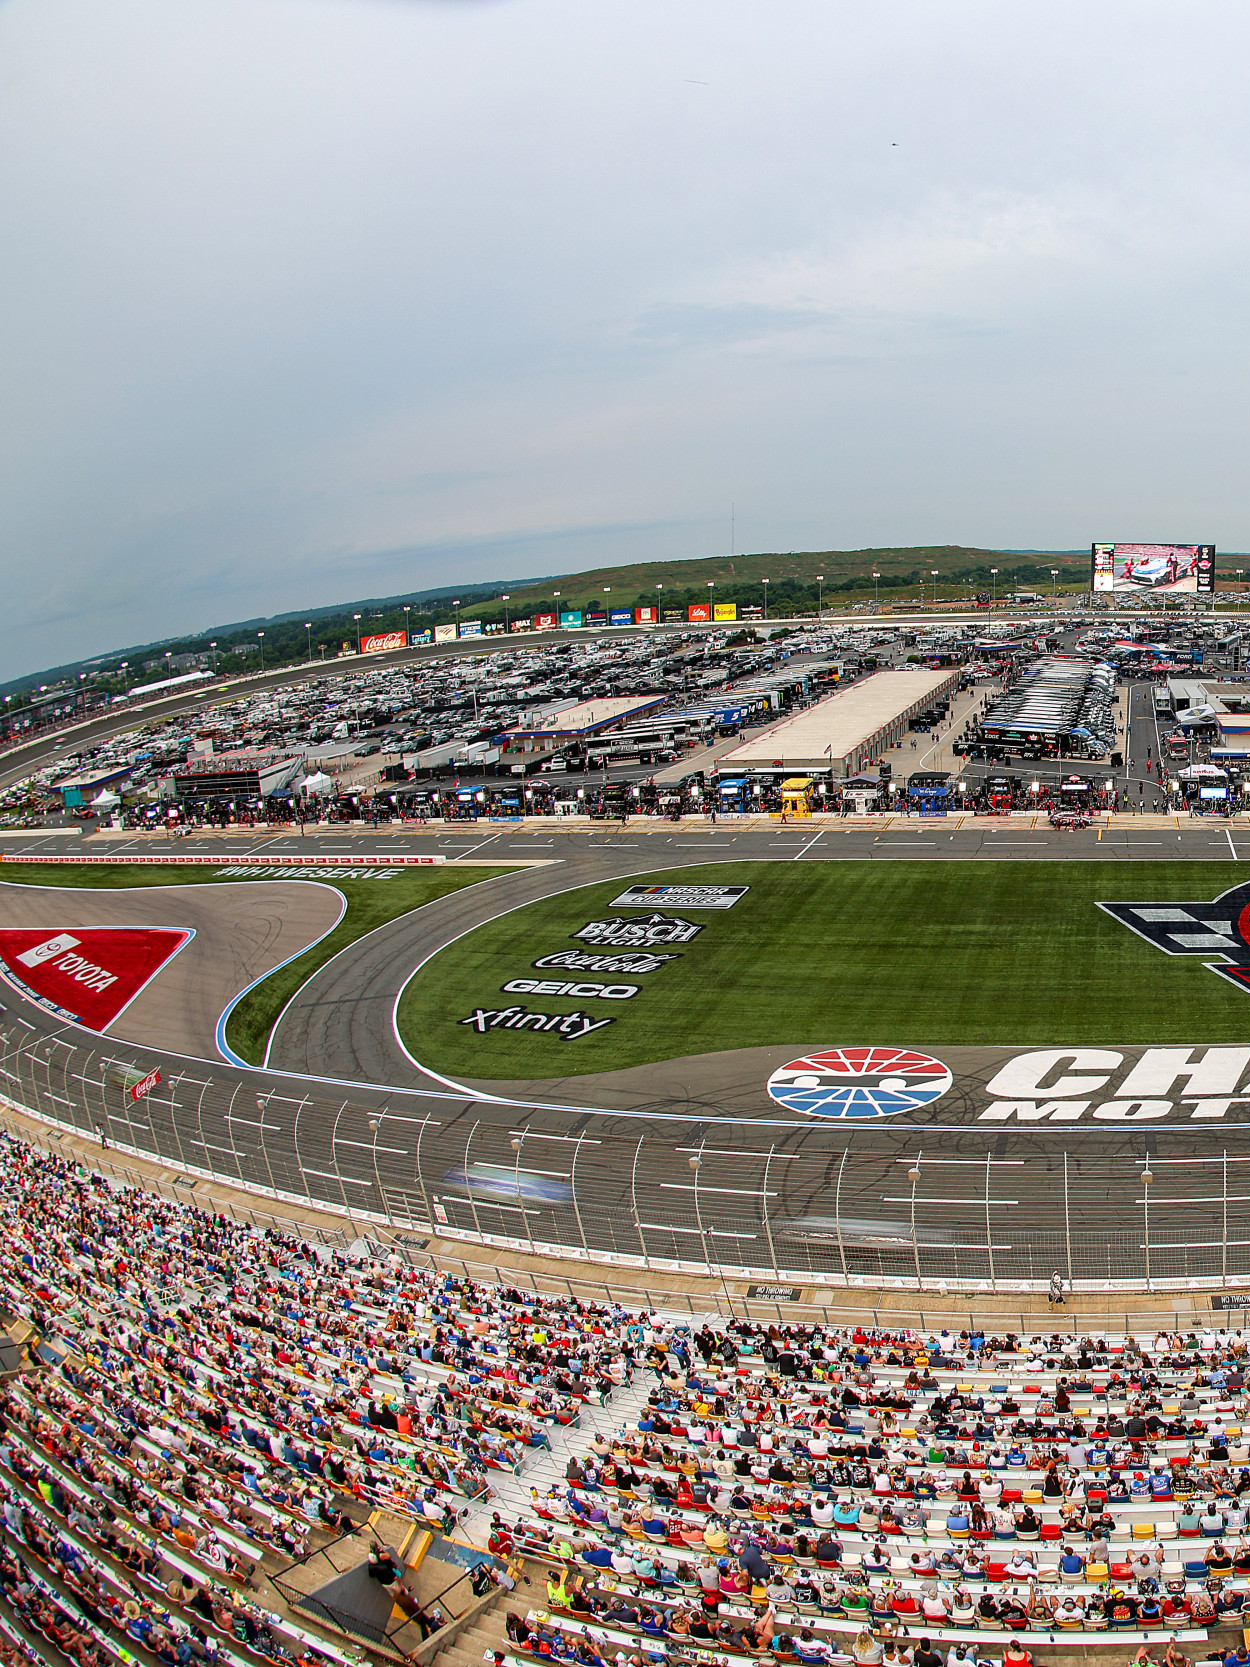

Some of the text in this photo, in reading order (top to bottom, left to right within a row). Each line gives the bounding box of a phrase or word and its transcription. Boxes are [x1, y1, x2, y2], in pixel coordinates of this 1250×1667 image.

[212, 865, 405, 880] #WHYWESERVE
[664, 886, 730, 896] NASCAR
[573, 921, 701, 942] BUSCH
[591, 937, 658, 946] LIGHT
[535, 950, 684, 973] Coca-Cola
[52, 952, 119, 993] TOYOTA
[503, 979, 639, 999] GEICO
[461, 1006, 611, 1039] xfinity
[756, 1285, 793, 1296] NO THROWING
[1221, 1295, 1230, 1304] NO
